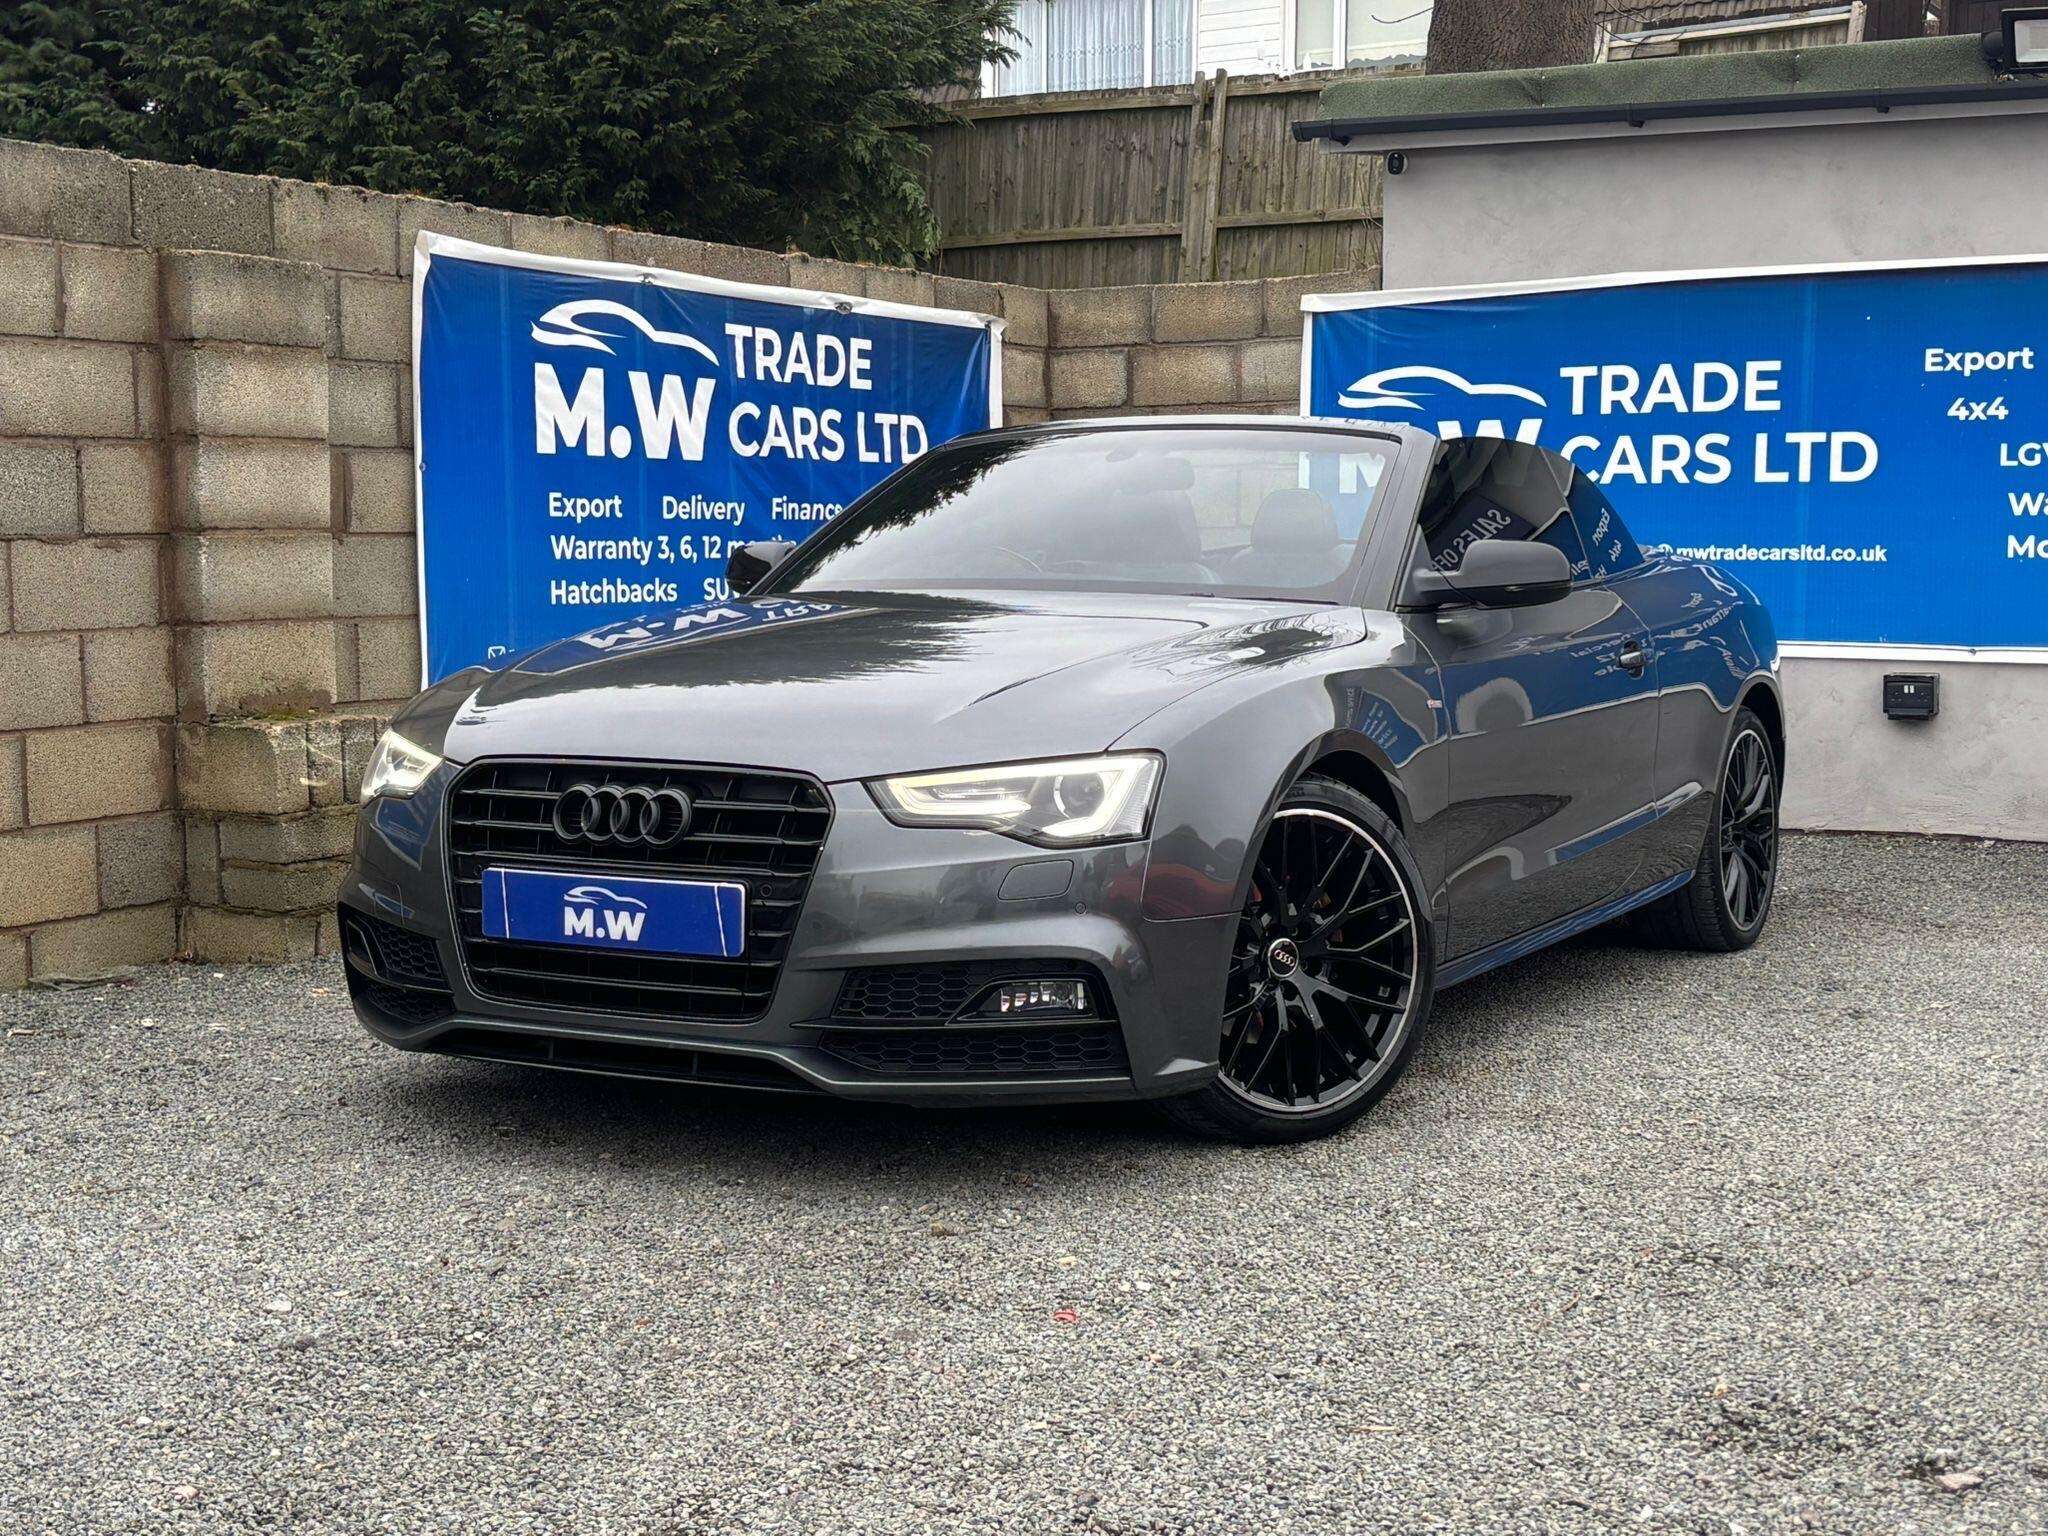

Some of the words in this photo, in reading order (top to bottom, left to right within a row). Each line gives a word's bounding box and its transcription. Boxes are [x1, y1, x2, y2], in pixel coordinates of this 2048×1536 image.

[725, 323, 872, 390] TRADE
[1924, 347, 2034, 377] Export
[1560, 360, 1782, 416] TRADE
[535, 362, 718, 461] M.W
[1947, 396, 2009, 421] 4x4
[729, 401, 845, 461] CARS
[857, 411, 928, 464] LTD
[1560, 433, 1731, 485] CARS
[1755, 431, 1878, 483] LTD
[2000, 442, 2048, 467] LG
[548, 492, 623, 523] Export
[662, 495, 745, 526] Delivery
[550, 534, 653, 566] Warranty
[657, 535, 675, 564] 3,
[679, 535, 698, 564] 6,
[702, 535, 722, 559] 12
[1676, 544, 1887, 562] mwtradecarsltd.co.uk
[550, 578, 678, 605] Hatchbacks
[703, 577, 741, 601] SU
[564, 907, 646, 942] M.W
